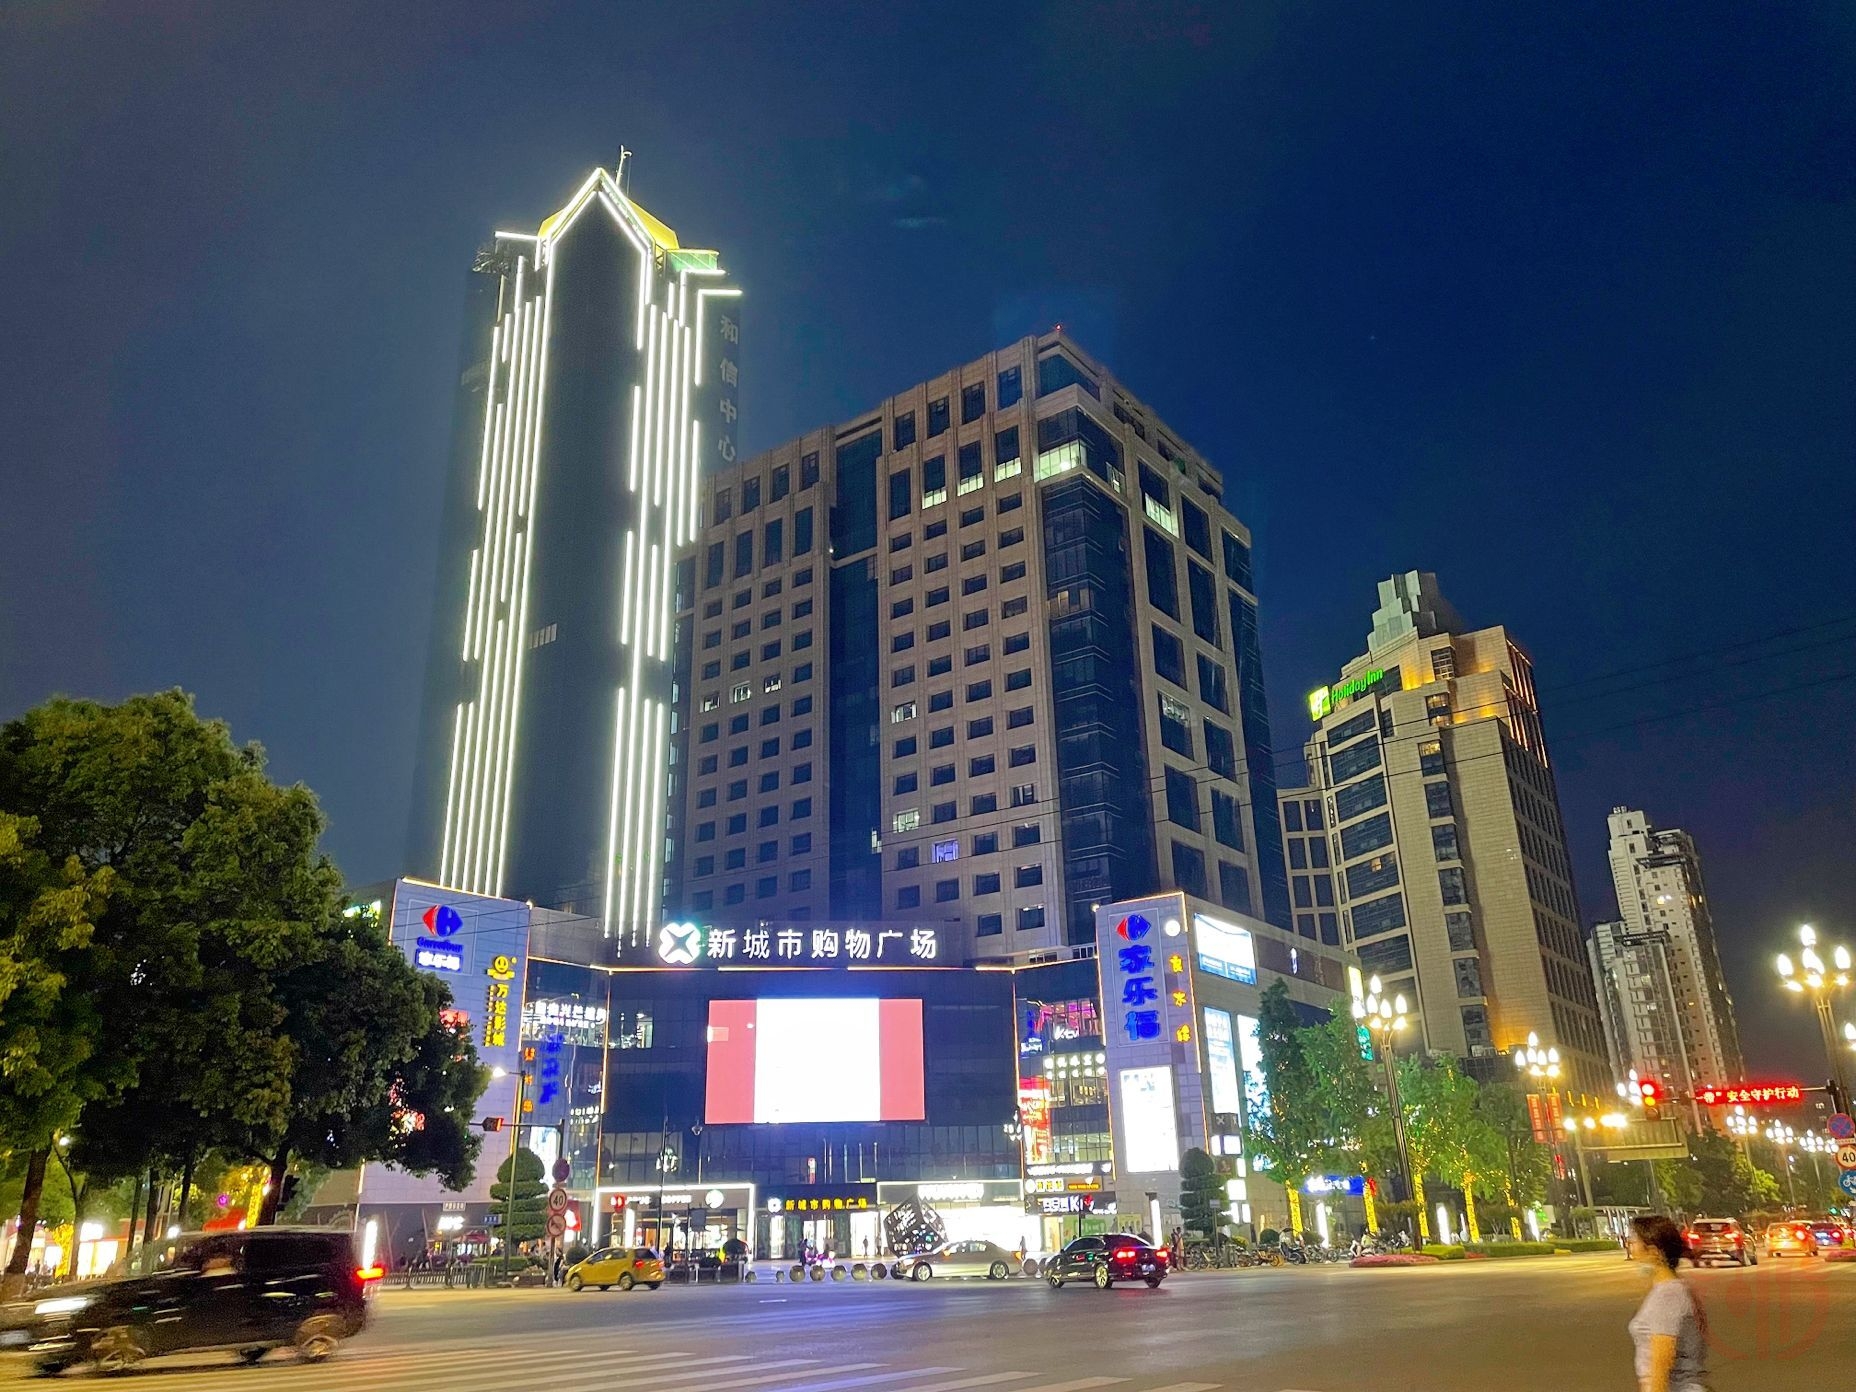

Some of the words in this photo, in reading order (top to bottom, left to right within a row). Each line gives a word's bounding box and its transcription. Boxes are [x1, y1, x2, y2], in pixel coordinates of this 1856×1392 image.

[718, 315, 739, 462] 和信中心
[1331, 677, 1367, 704] Holiday
[1367, 669, 1384, 686] Inn
[707, 928, 937, 959] 新城市购物广场
[1118, 944, 1160, 1041] 家乐福
[1842, 1151, 1856, 1163] 40
[553, 1195, 564, 1206] 40
[785, 1198, 867, 1211] 新城市购物广场
